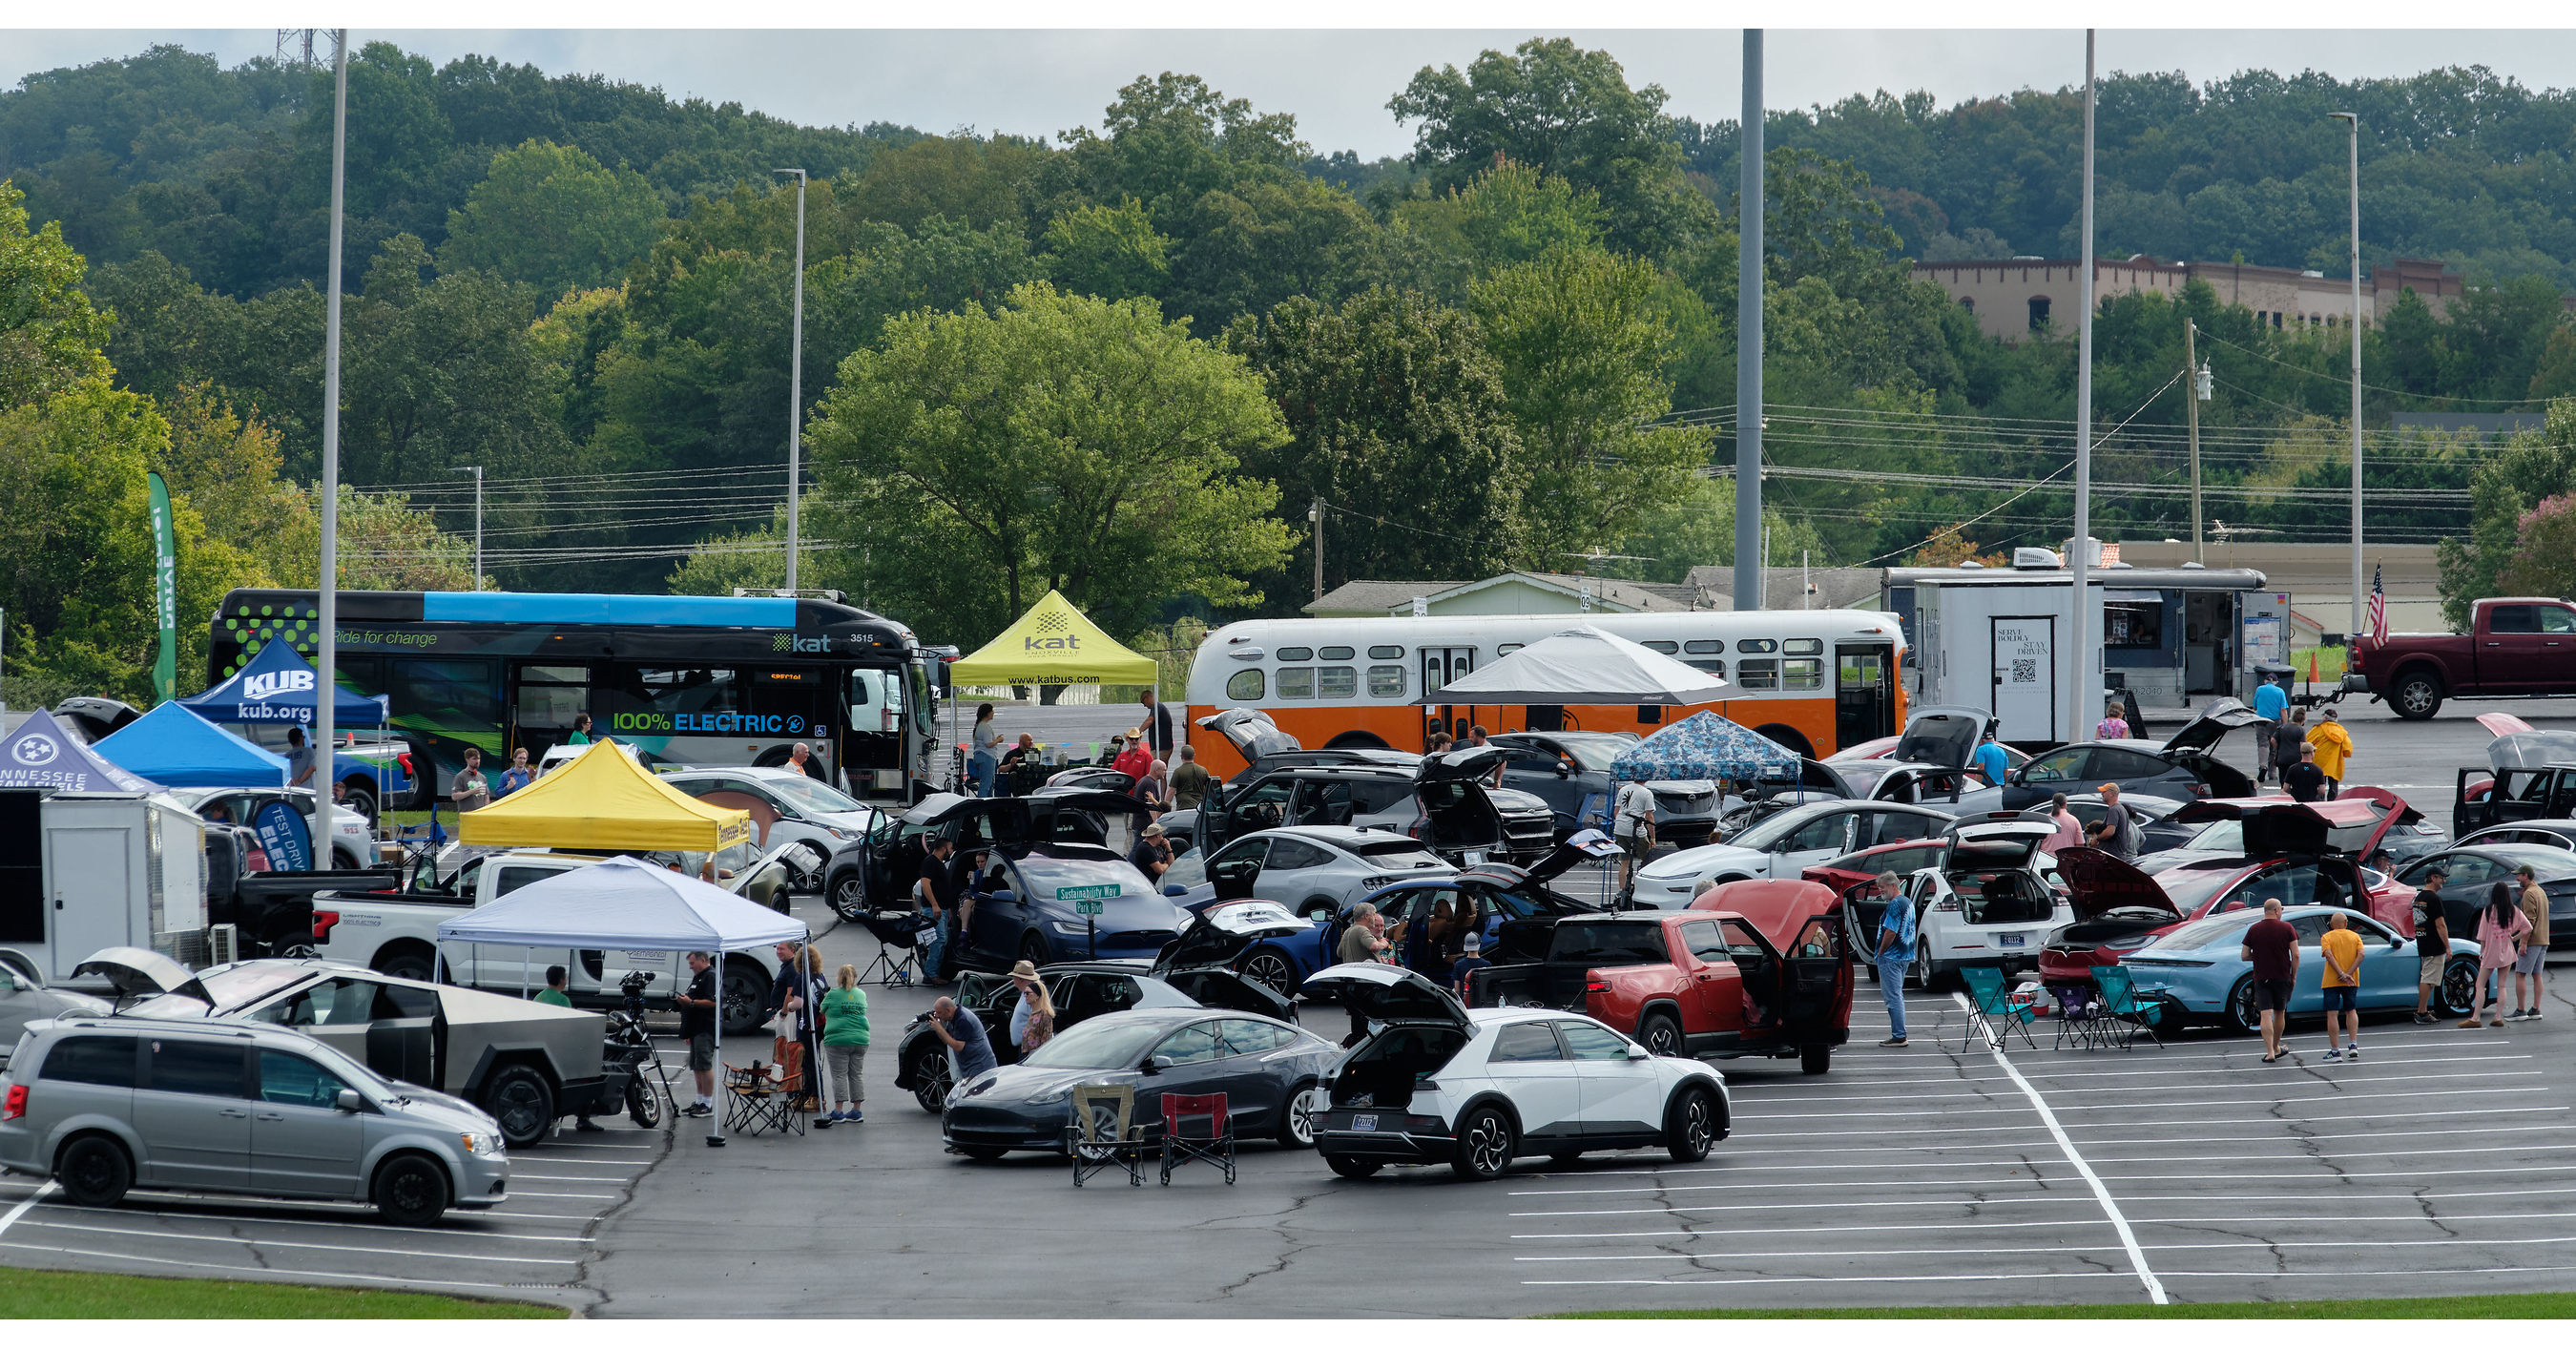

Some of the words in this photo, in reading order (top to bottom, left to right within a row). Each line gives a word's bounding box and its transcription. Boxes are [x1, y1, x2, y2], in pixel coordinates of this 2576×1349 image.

[334, 631, 360, 643] Ride
[364, 631, 383, 643] for
[385, 632, 437, 648] change
[792, 633, 831, 653] kat
[850, 633, 874, 643] 3515
[1025, 634, 1081, 651] kat
[243, 670, 314, 695] KUB
[1008, 675, 1100, 685] www.katbus.com
[238, 702, 312, 723] kub.org
[613, 713, 671, 731] 100%
[675, 714, 782, 733] ELECTRIC
[272, 806, 292, 837] TEST
[284, 839, 306, 871] DRIV
[1060, 886, 1103, 900] Sustainability
[1104, 885, 1117, 897] Way
[1077, 903, 1090, 913] Park
[1091, 903, 1103, 913] Blvd
